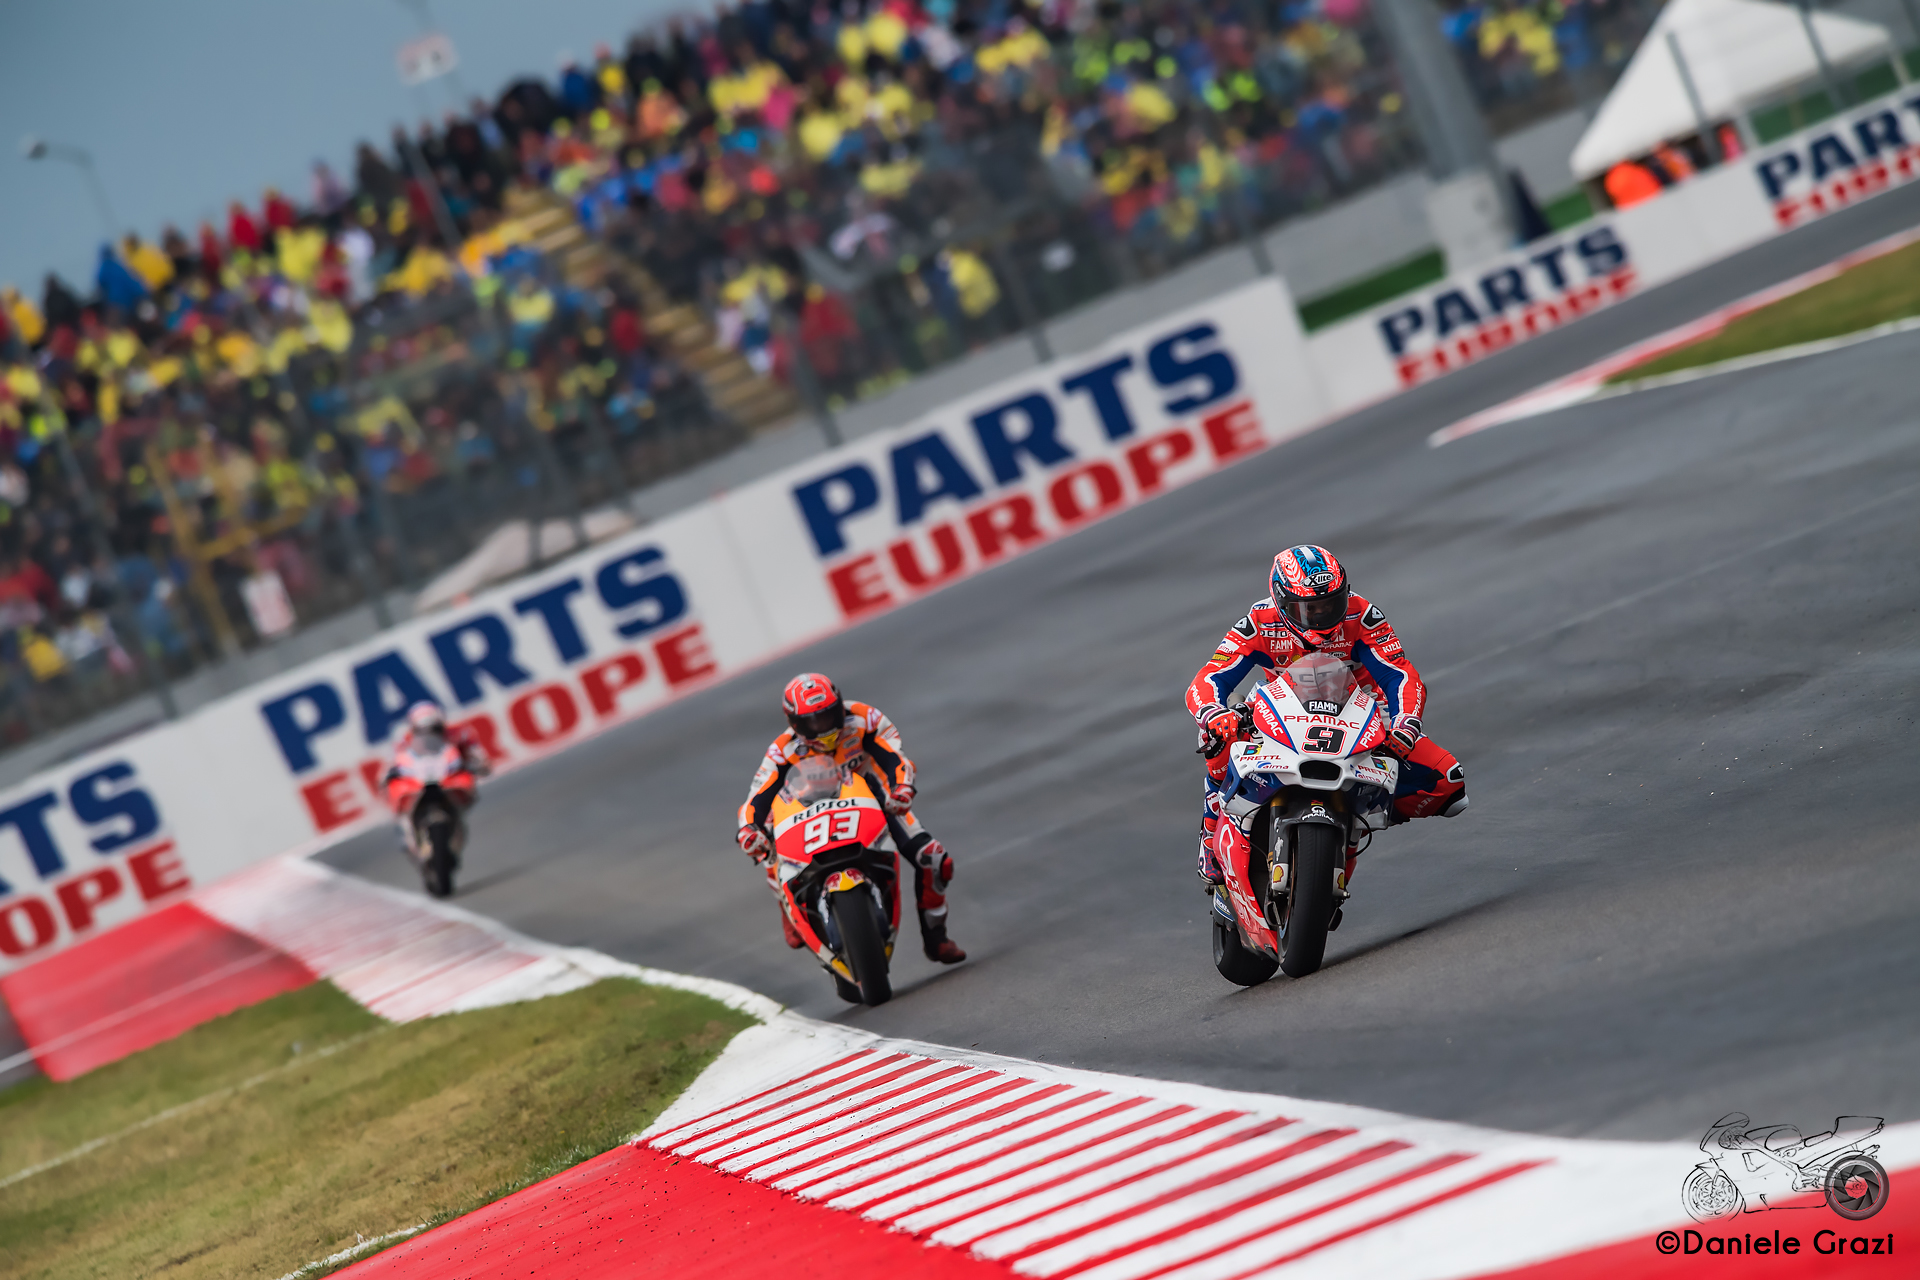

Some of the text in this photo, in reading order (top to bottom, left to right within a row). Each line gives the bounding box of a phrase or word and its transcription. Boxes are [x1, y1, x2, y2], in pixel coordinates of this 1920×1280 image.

[1378, 226, 1627, 355] PARTS
[792, 320, 1240, 559] PARTS
[824, 397, 1269, 622] EUROPE
[260, 543, 690, 774] PARTS
[1254, 699, 1284, 737] PRAMAC
[1284, 715, 1360, 729] PRAMAC
[1309, 701, 1338, 713] FIAMM
[1301, 725, 1347, 756] 9
[793, 798, 859, 823] REPSOL
[804, 809, 861, 855] 93
